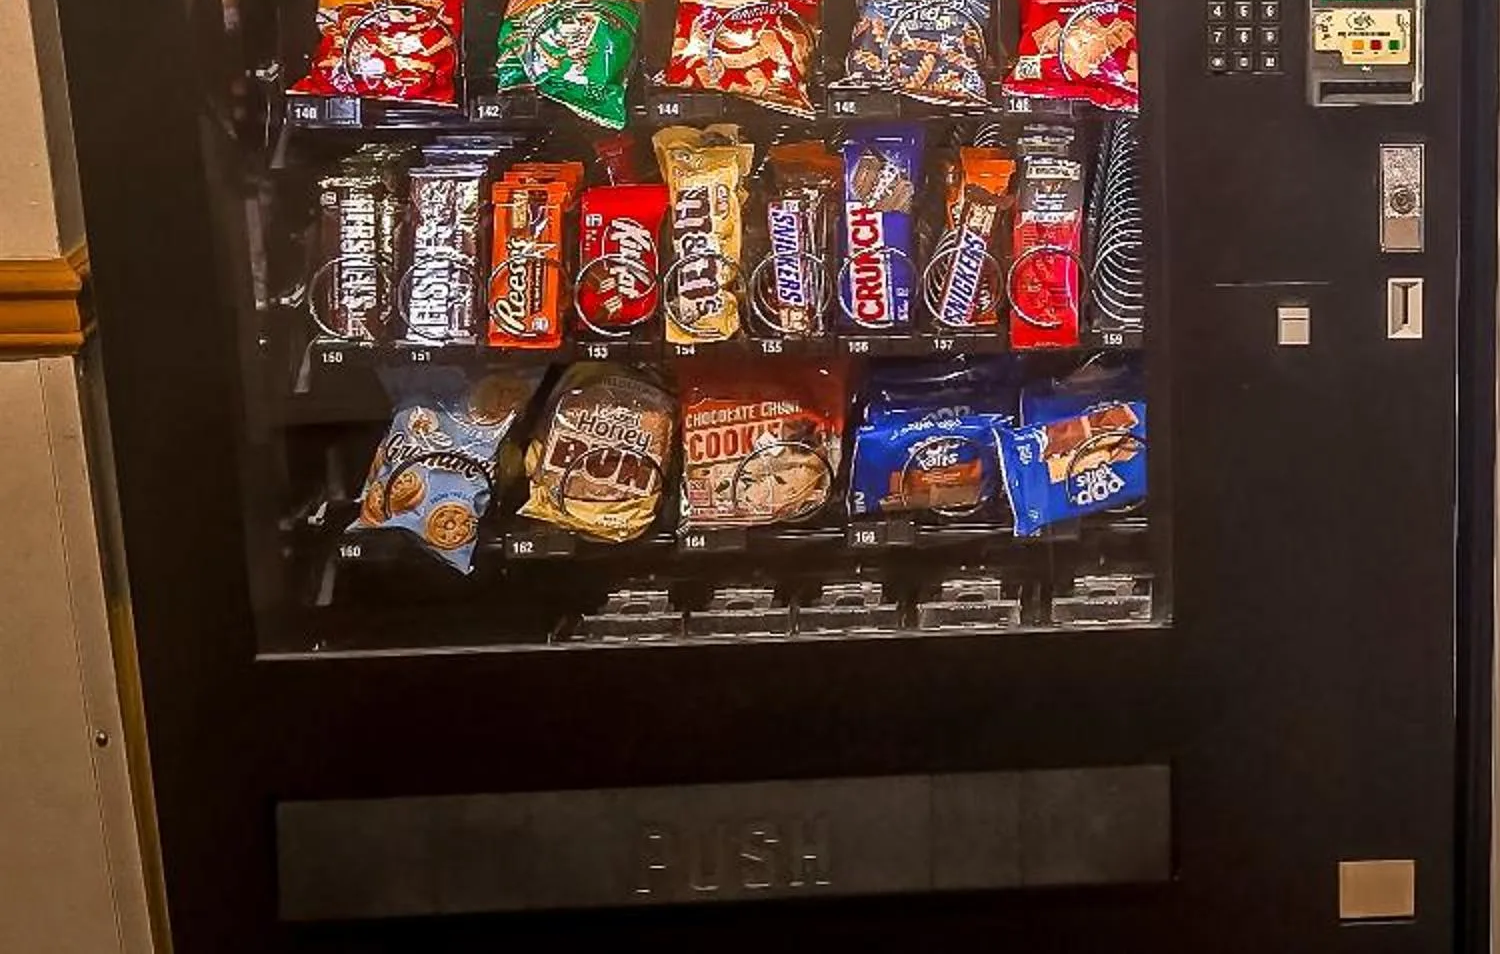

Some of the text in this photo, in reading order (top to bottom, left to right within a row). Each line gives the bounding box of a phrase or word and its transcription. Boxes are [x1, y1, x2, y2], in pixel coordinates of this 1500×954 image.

[295, 107, 317, 118] 140
[478, 106, 499, 118] 142
[657, 103, 679, 114] 144
[770, 206, 804, 306] SNICKERS
[850, 204, 885, 324] CRUNCH
[942, 230, 987, 326] SNICKERS
[934, 339, 954, 350] 157
[1102, 334, 1123, 345] 159
[588, 346, 609, 358] 153
[761, 341, 782, 353] 155
[322, 353, 343, 364] 150
[411, 352, 430, 362] 151
[686, 405, 758, 429] CHOCOLATE
[578, 410, 651, 451] Honey
[513, 542, 533, 553] 162
[636, 817, 834, 894] PUSH
